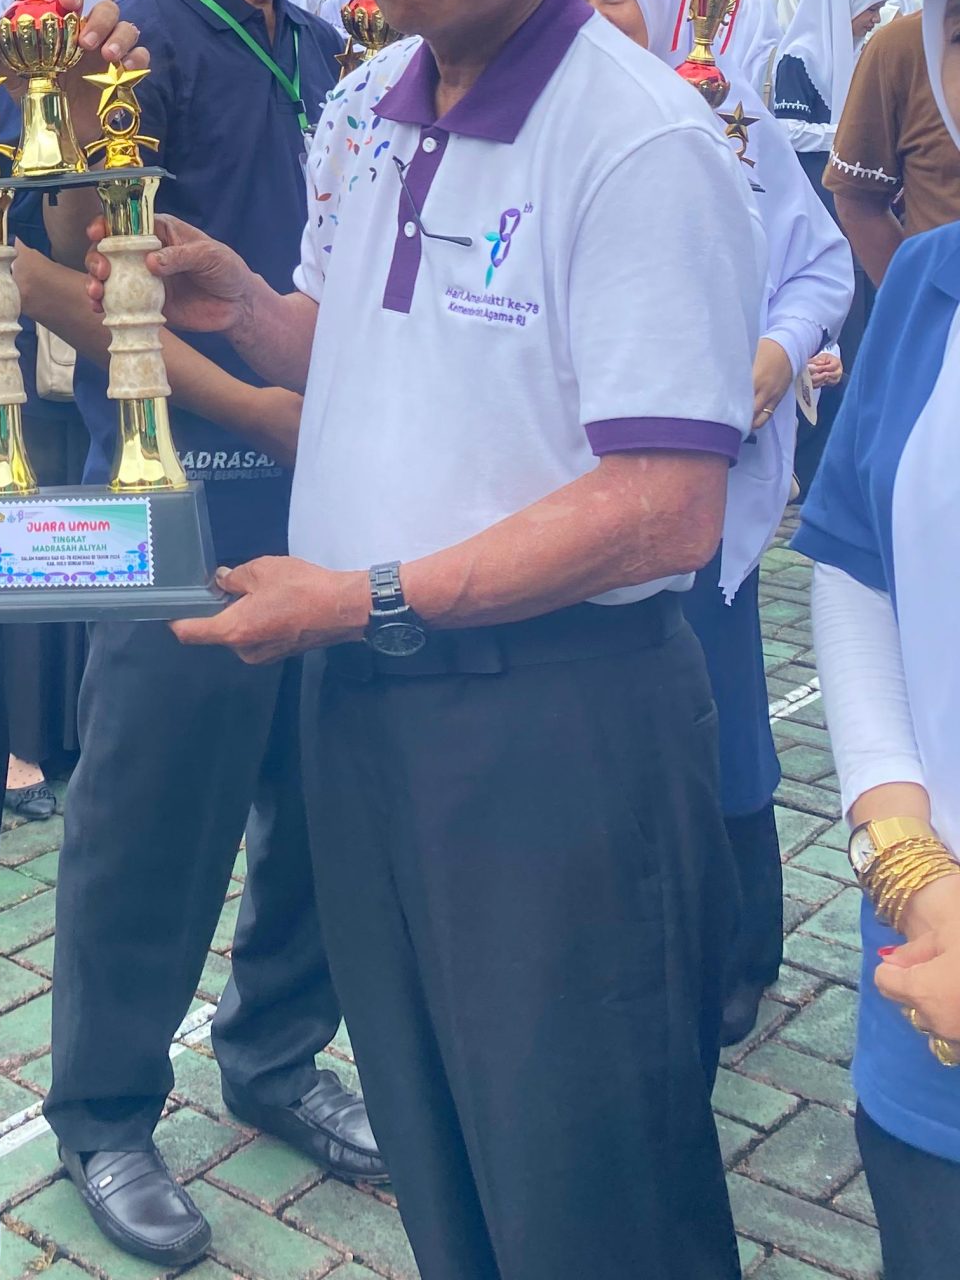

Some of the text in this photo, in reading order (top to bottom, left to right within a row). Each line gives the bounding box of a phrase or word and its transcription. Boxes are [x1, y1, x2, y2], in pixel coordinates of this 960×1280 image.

[507, 298, 540, 315] ke-78
[483, 310, 514, 324] Agama
[515, 315, 527, 327] RI
[177, 450, 276, 469] ADRASA
[26, 520, 111, 533] JUARA UMUM
[51, 535, 86, 543] TINGKAT
[32, 544, 107, 553] MADRASAH ALIYAH
